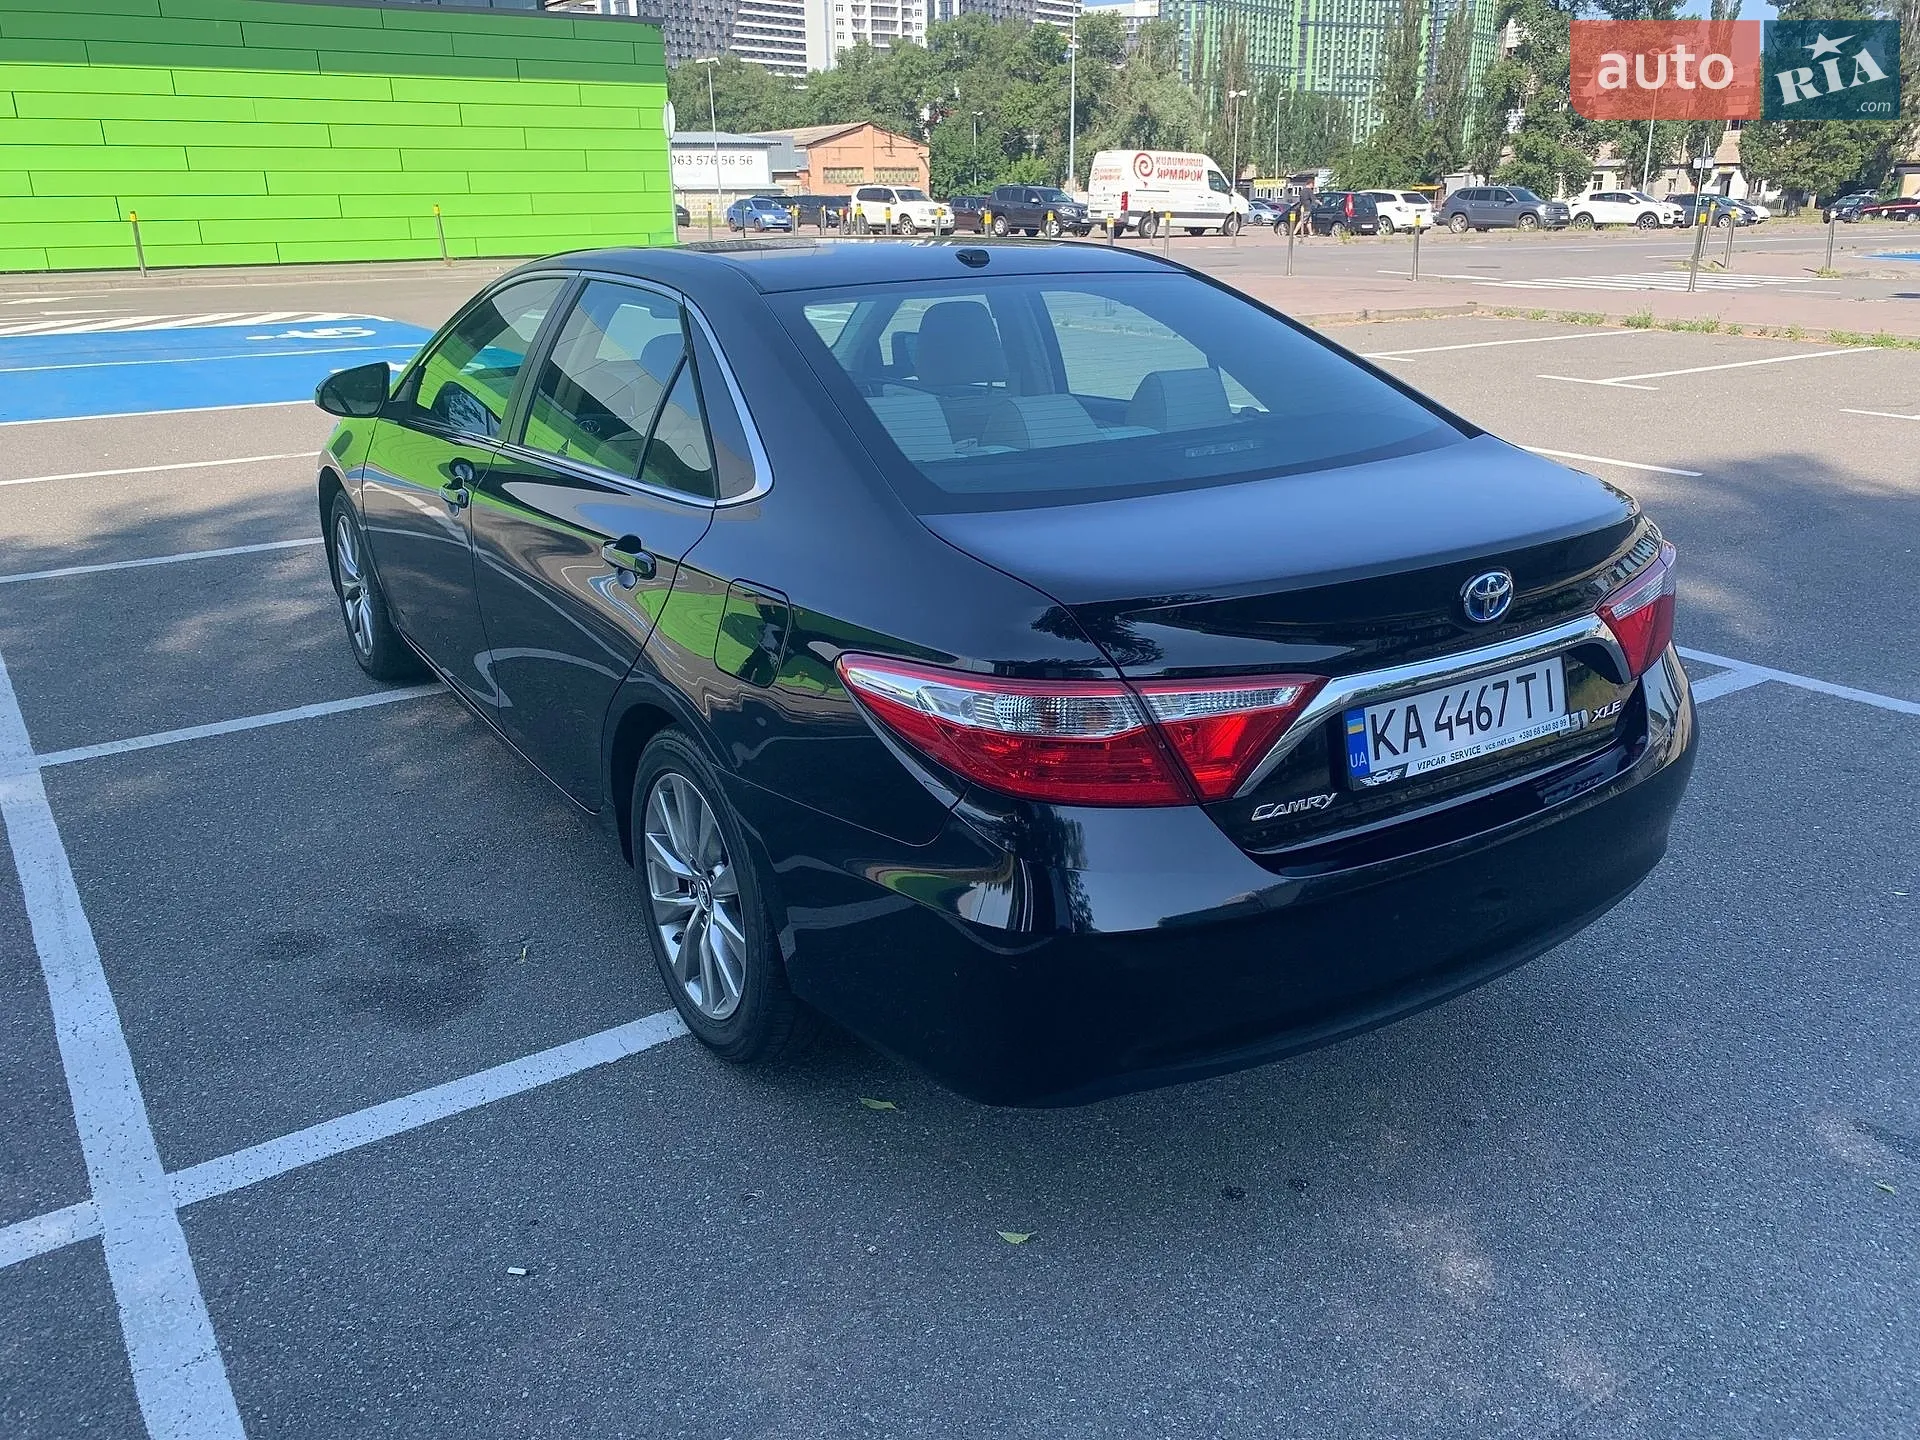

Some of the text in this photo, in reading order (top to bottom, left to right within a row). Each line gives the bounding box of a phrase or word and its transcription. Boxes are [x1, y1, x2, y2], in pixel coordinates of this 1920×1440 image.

[696, 155, 717, 166] 576
[721, 155, 736, 166] 56
[739, 155, 753, 166] 56
[1370, 668, 1554, 761] KA 4467 TI
[1590, 700, 1622, 723] XLE
[1350, 752, 1367, 768] UA
[1417, 756, 1446, 771] VIPCAR
[1450, 745, 1481, 762] SERVICE
[1251, 792, 1338, 821] CAMRY
